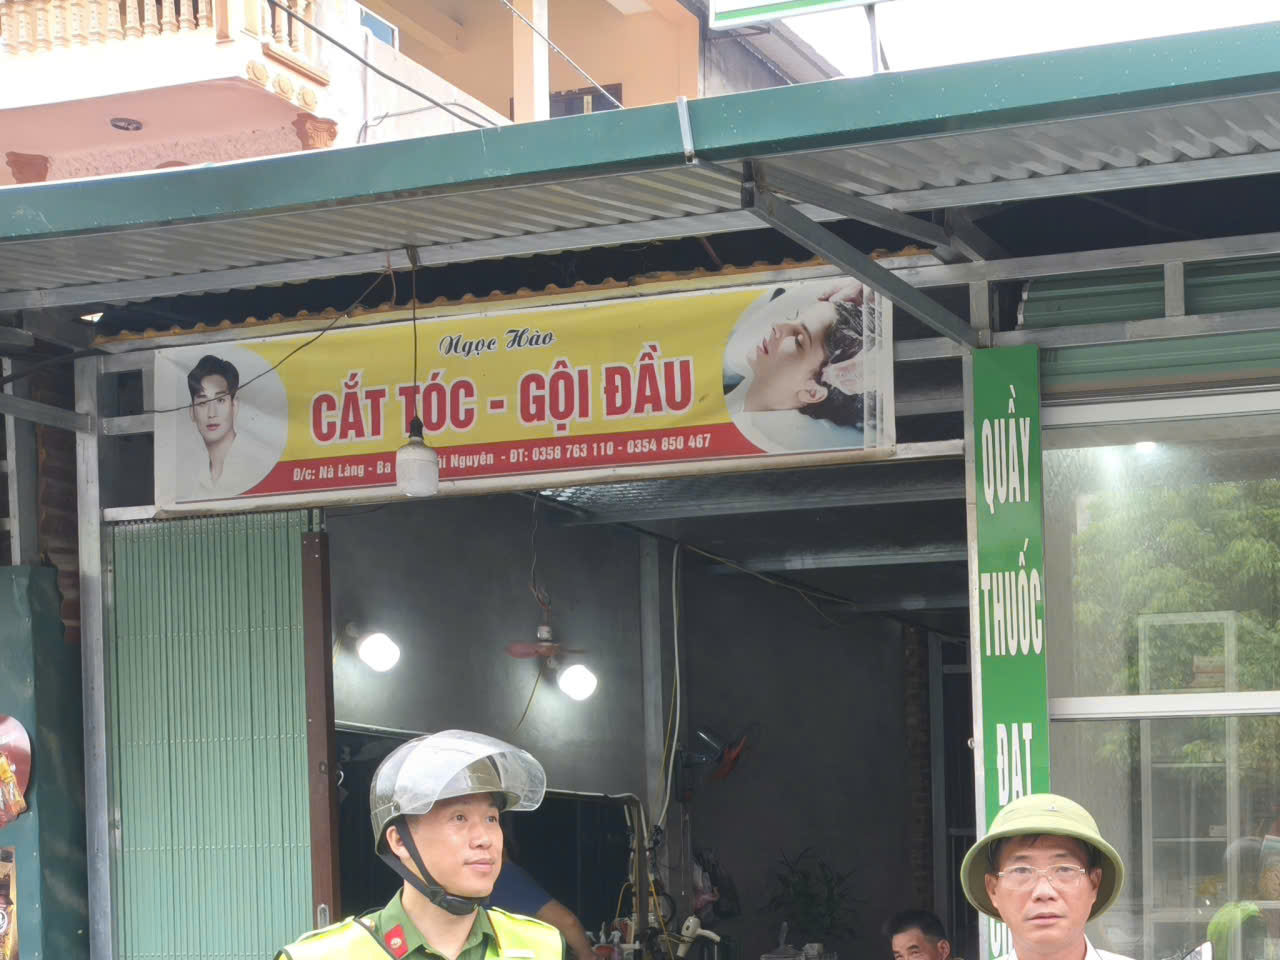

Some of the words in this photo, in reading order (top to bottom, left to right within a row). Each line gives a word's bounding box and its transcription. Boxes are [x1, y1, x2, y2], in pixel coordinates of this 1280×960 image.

[440, 335, 496, 357] Ngọc
[505, 328, 555, 347] Hào
[312, 372, 386, 442] CẮT
[399, 372, 475, 433] TÓC
[520, 359, 589, 432] GỘI
[604, 344, 692, 416] ĐẦU
[319, 466, 334, 479] Nà
[338, 464, 364, 479] Làng
[377, 461, 391, 474] Ba
[450, 452, 494, 468] Nguyên
[510, 449, 528, 463] ĐT:
[532, 446, 561, 462] 0358
[566, 444, 588, 458] 763
[593, 442, 614, 456] 110
[627, 438, 658, 454] 0354
[662, 436, 684, 451] 850
[688, 434, 712, 448] 467
[982, 384, 1031, 514] QUẦY
[981, 538, 1042, 656] THUỐC
